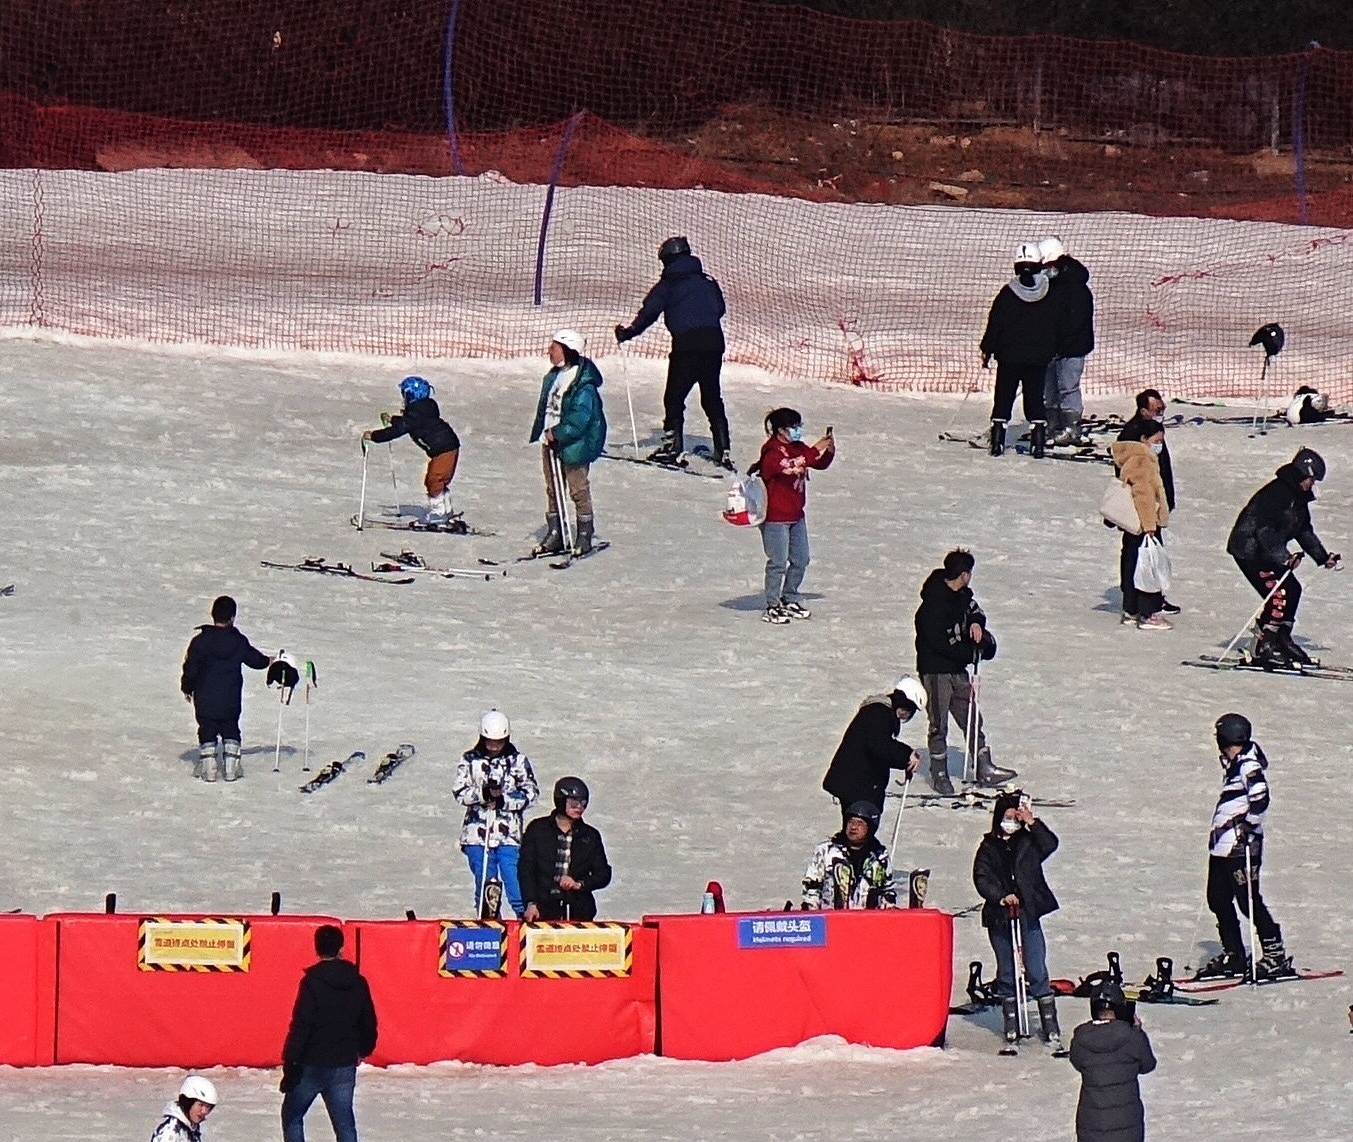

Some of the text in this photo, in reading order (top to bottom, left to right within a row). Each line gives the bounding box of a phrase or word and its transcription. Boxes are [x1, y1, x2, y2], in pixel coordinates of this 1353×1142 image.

[752, 920, 812, 934] 请佩戴头盔
[752, 935, 812, 944] Helmets required
[536, 943, 618, 953] 雪道终点处禁止停留
